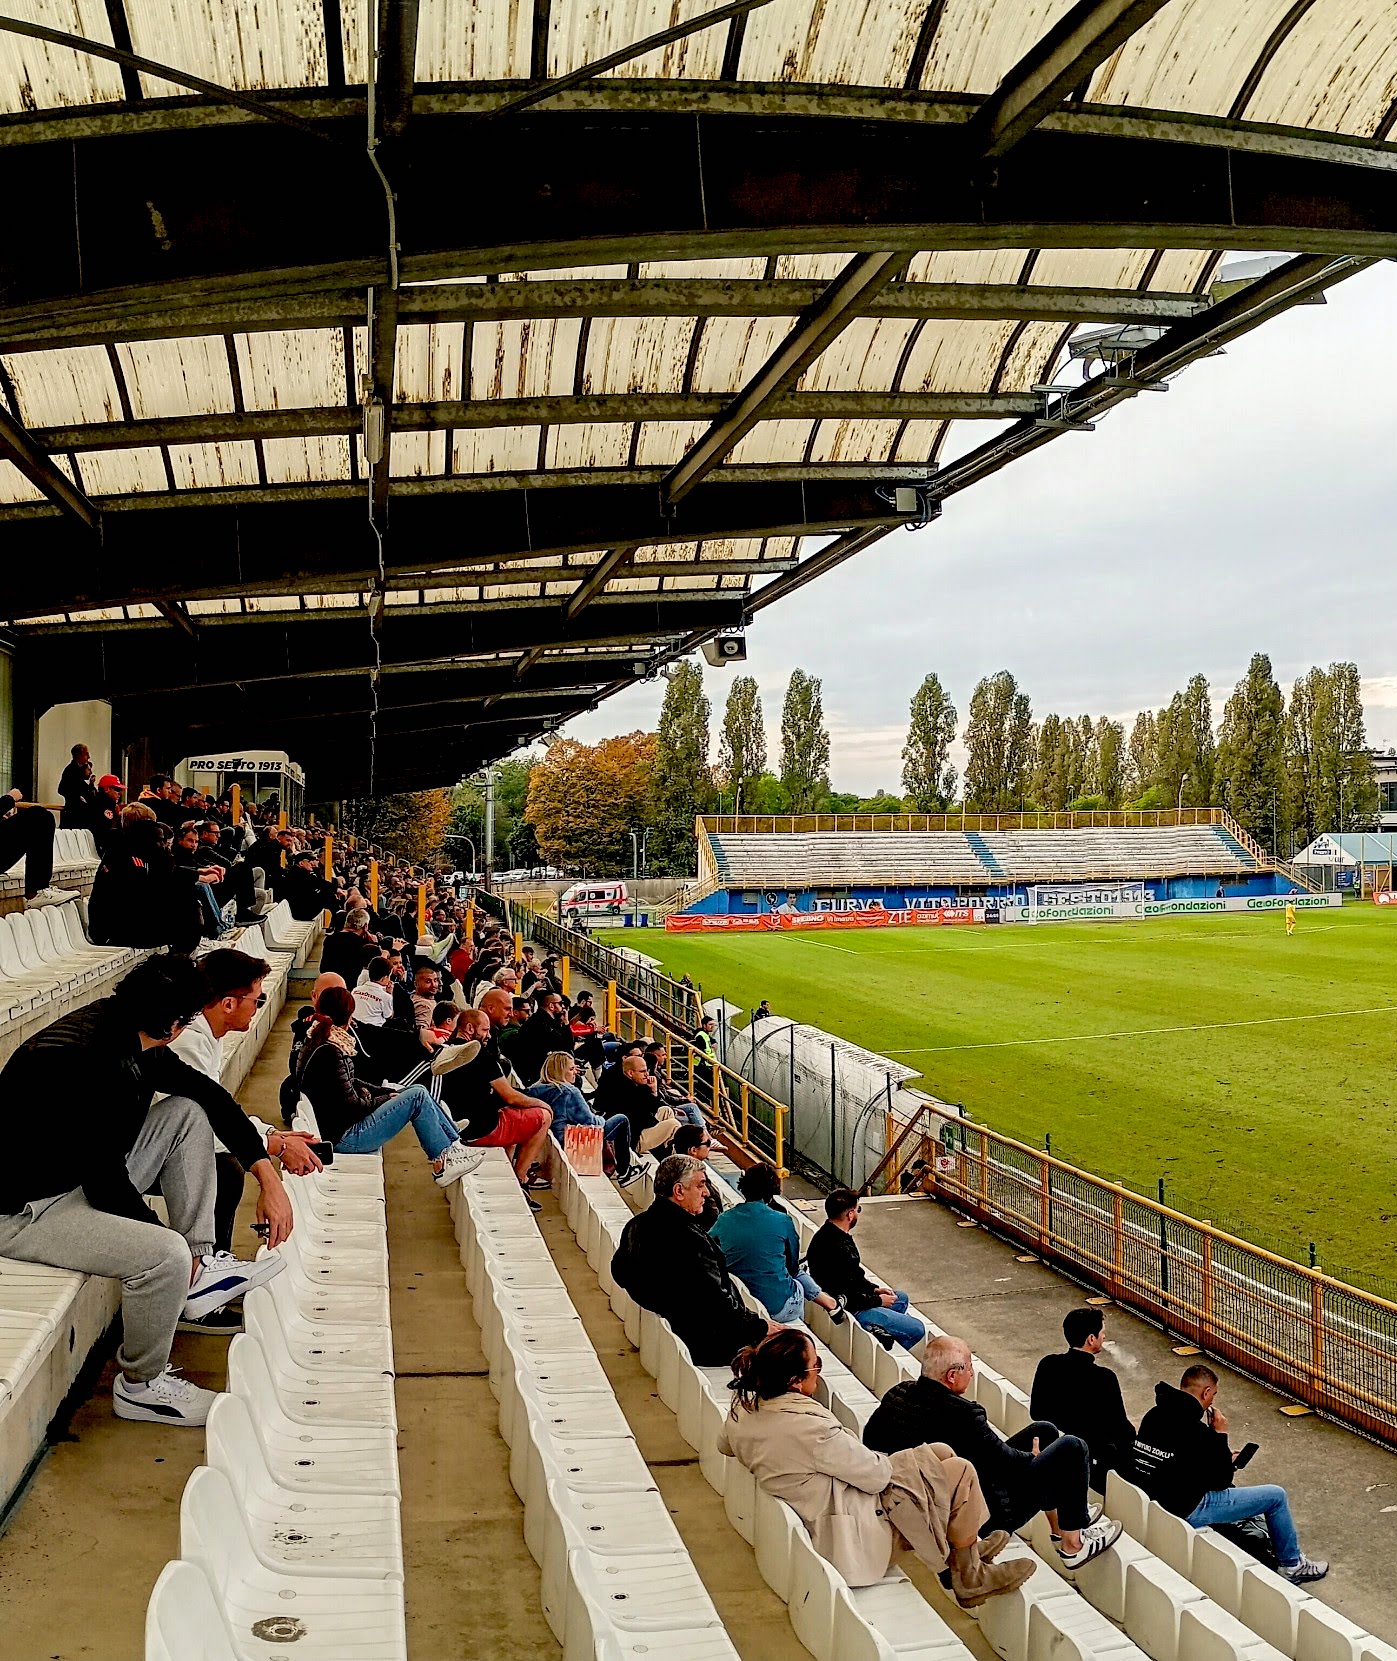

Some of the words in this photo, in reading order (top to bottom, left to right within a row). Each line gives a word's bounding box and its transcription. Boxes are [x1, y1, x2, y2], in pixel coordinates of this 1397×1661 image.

[190, 761, 215, 770] PRO
[217, 761, 255, 770] SETO
[258, 762, 283, 771] 1913
[887, 911, 913, 924] ZTE
